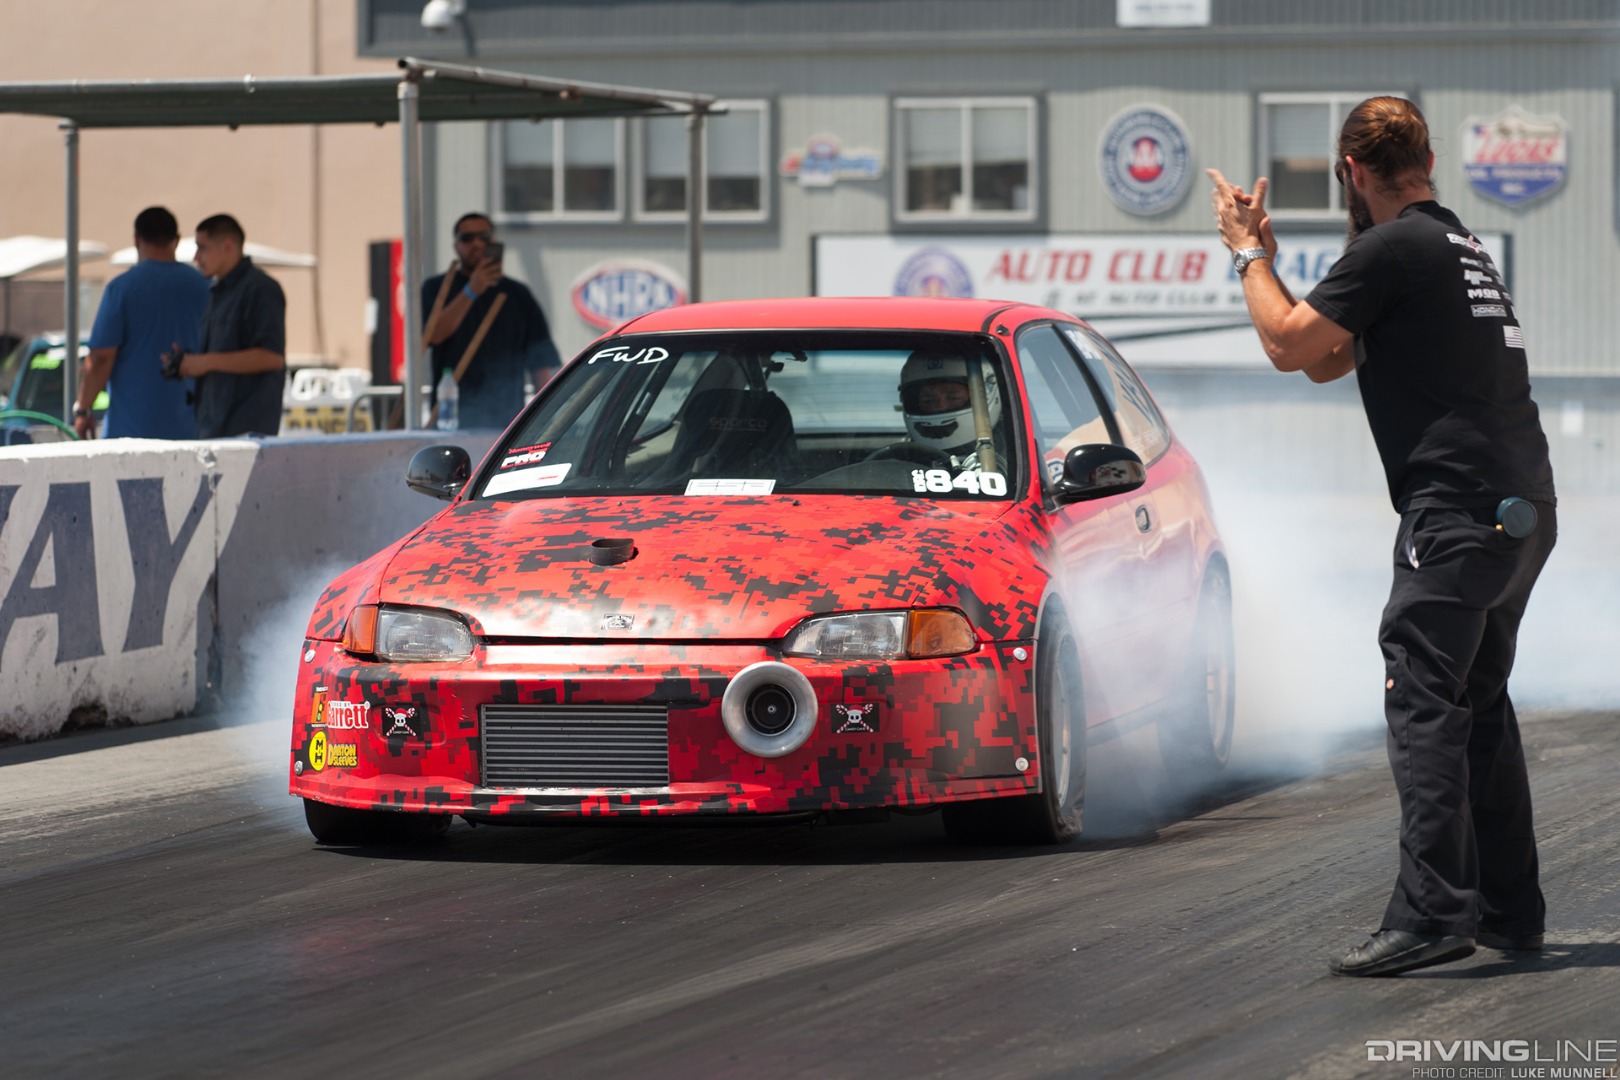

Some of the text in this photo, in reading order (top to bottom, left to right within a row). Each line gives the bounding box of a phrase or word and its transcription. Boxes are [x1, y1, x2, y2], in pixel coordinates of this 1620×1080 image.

[984, 250, 1092, 284] AUTO
[1108, 249, 1208, 283] CLUB
[588, 346, 669, 365] FWD
[501, 451, 547, 467] PRO
[925, 469, 1008, 497] 840
